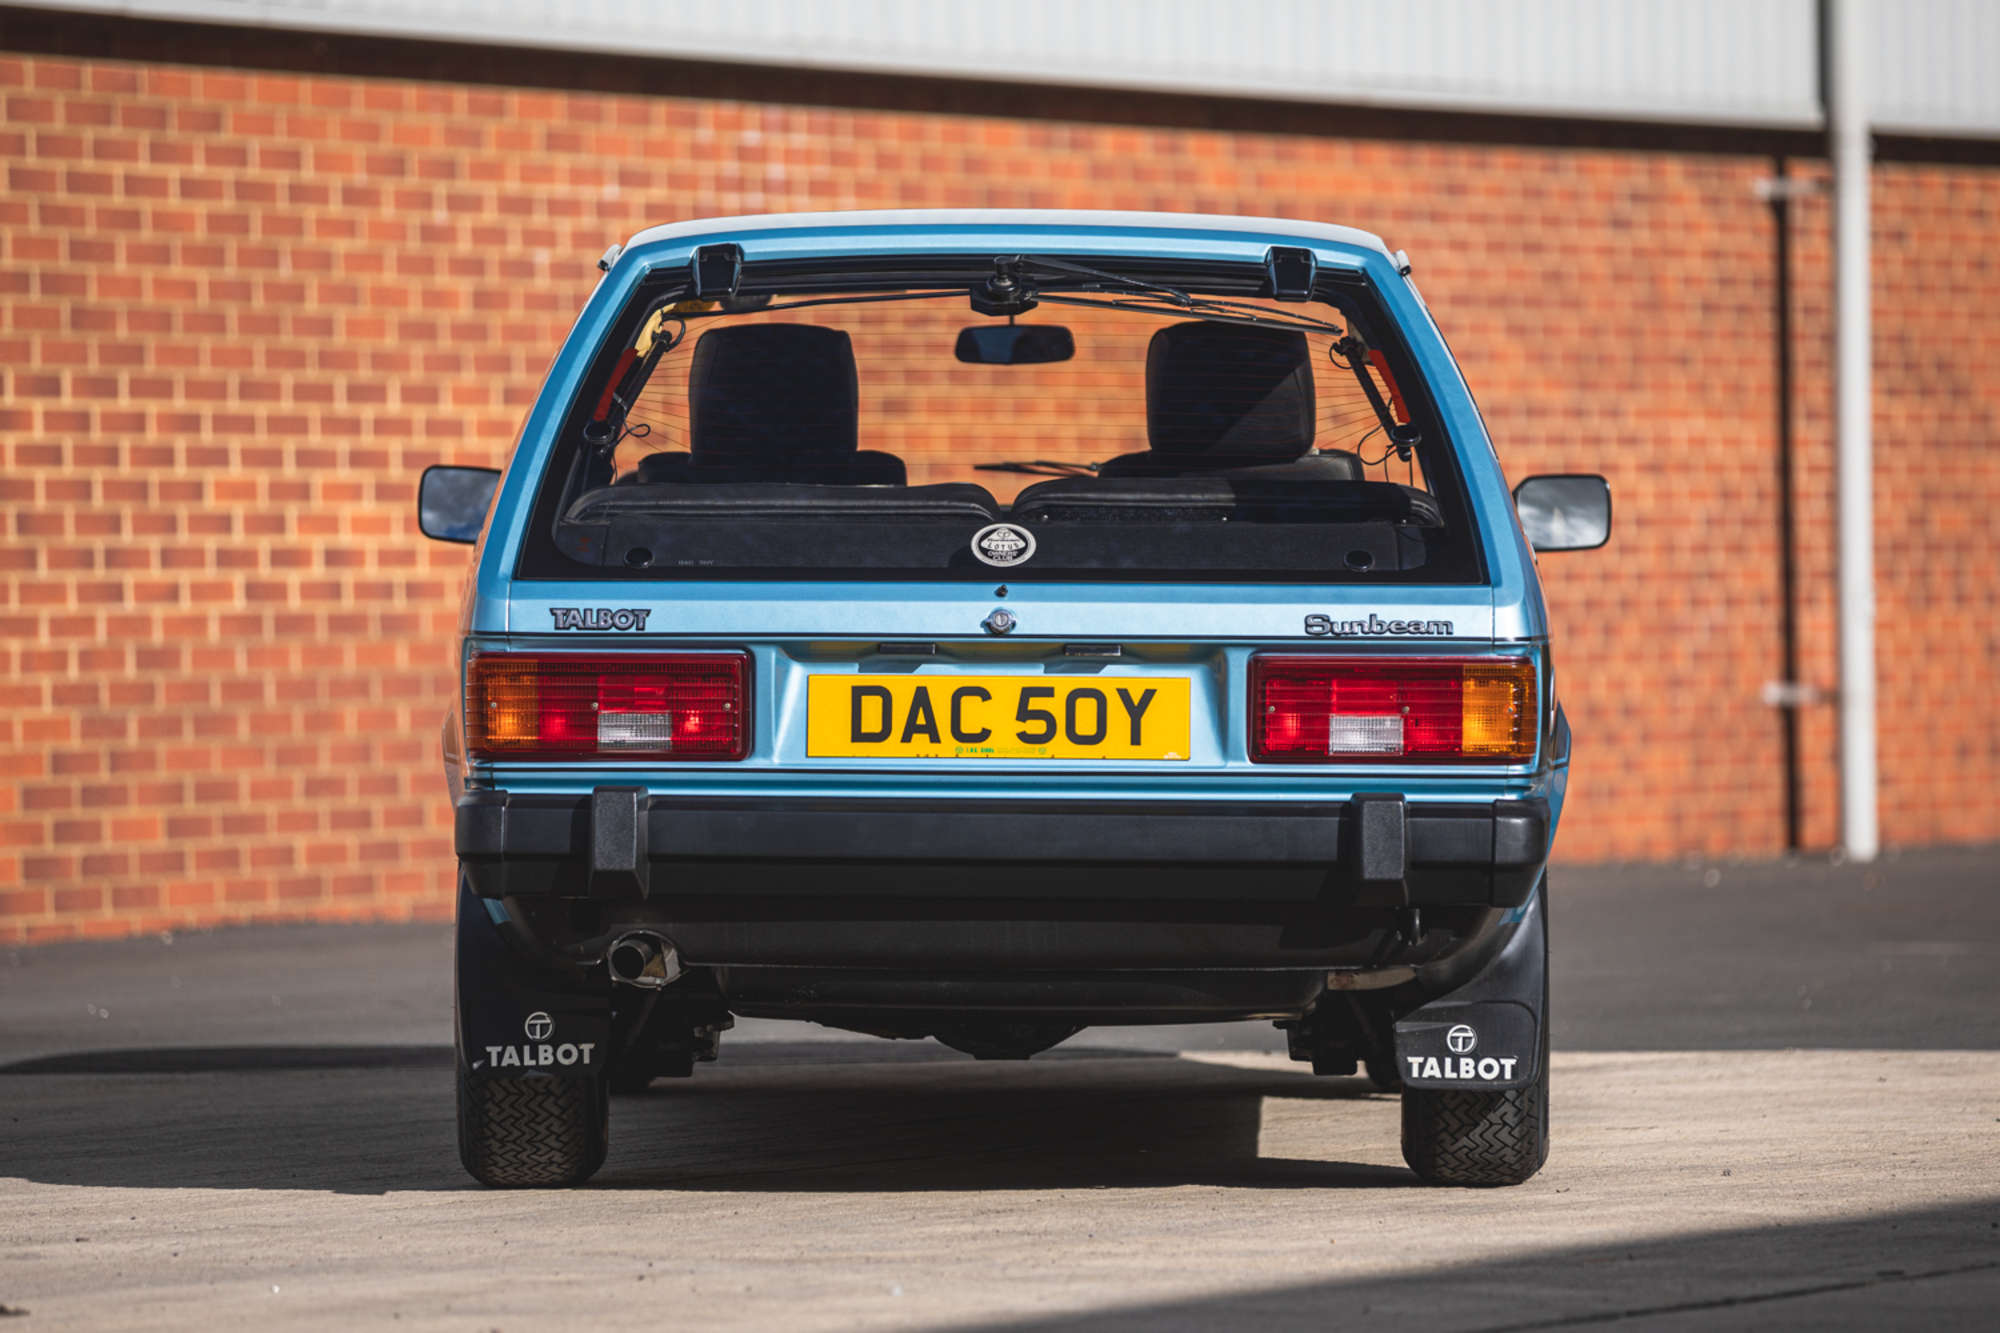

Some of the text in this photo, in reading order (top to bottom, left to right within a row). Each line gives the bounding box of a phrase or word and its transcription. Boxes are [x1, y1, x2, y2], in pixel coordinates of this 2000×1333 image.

[549, 607, 652, 631] TALBOT
[1304, 613, 1453, 636] Sunbeam
[850, 685, 1157, 746] DAC 50Y
[485, 1043, 595, 1067] TALBOT
[1406, 1056, 1518, 1080] TALBOT
